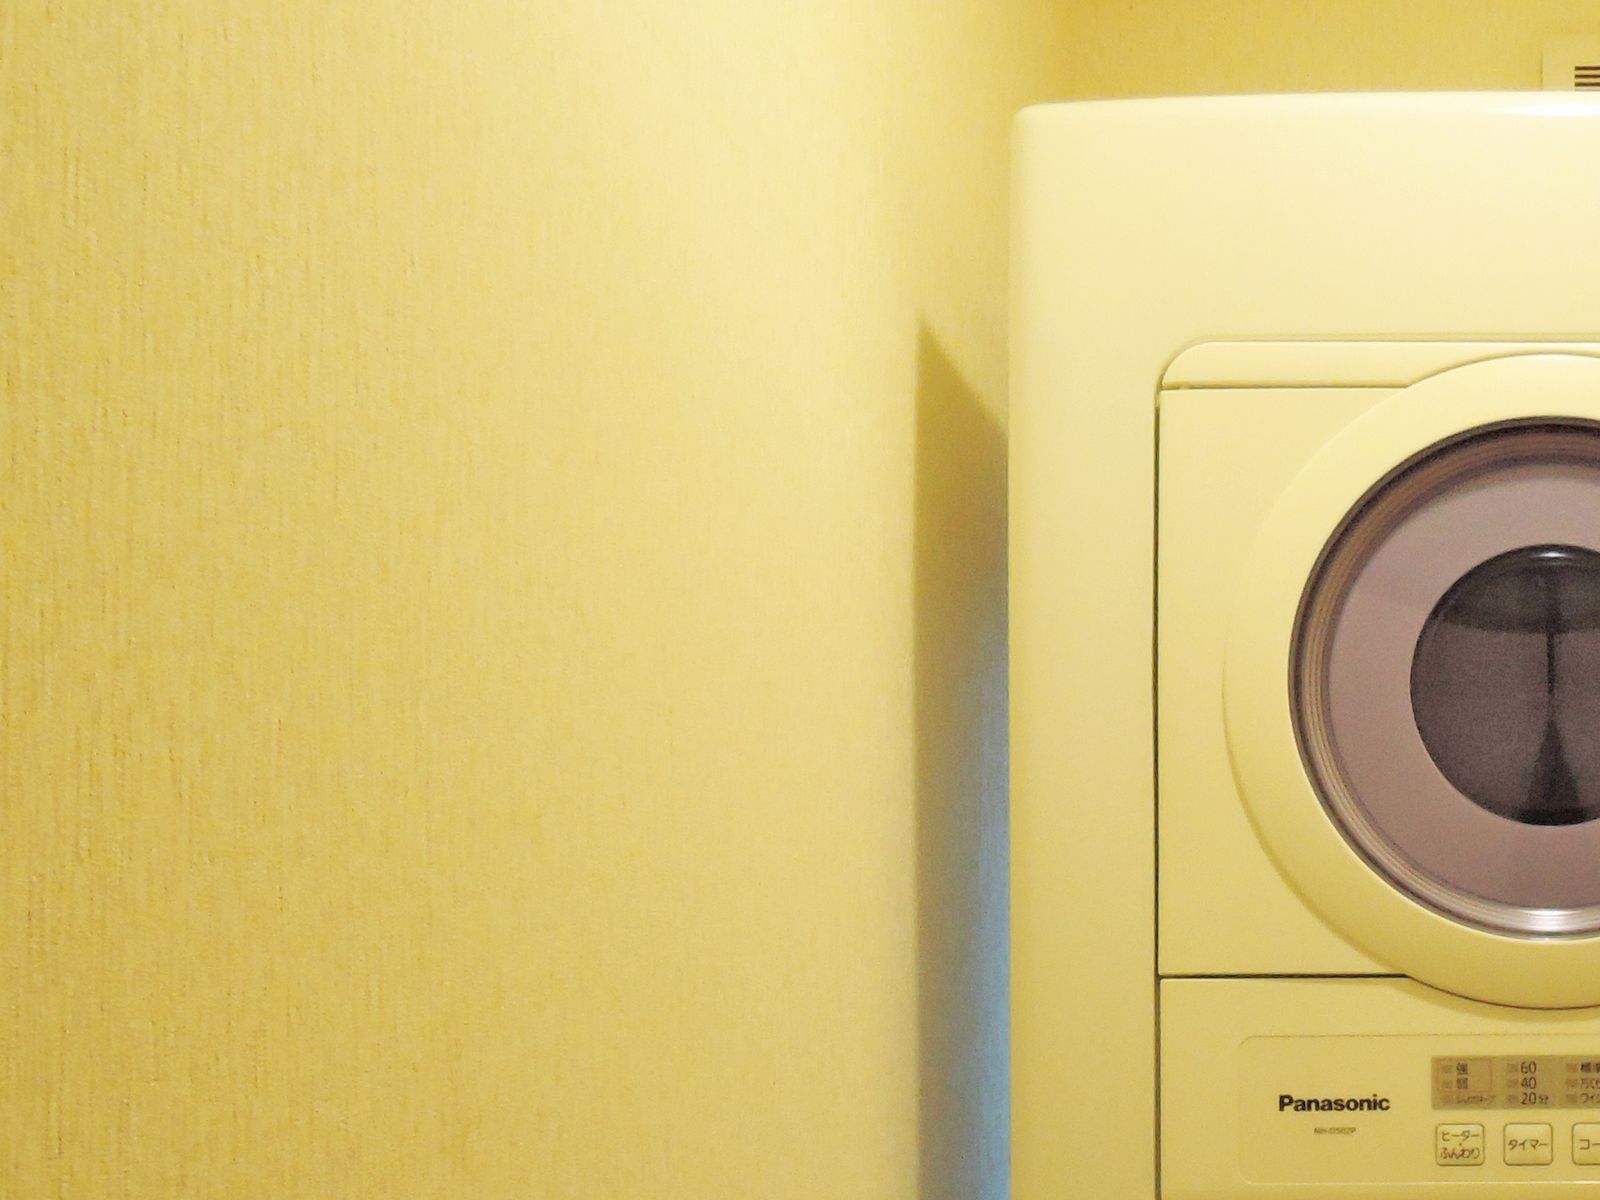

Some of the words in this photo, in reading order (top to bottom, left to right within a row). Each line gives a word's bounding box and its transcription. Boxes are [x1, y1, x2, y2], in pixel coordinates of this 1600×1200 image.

[1520, 1061, 1537, 1074] 60
[1520, 1076, 1537, 1089] 40
[1279, 1094, 1390, 1112] Panasonic
[1441, 1130, 1480, 1142] ヒーター
[1507, 1139, 1549, 1151] タイマー
[1440, 1147, 1480, 1160] ふんわり
